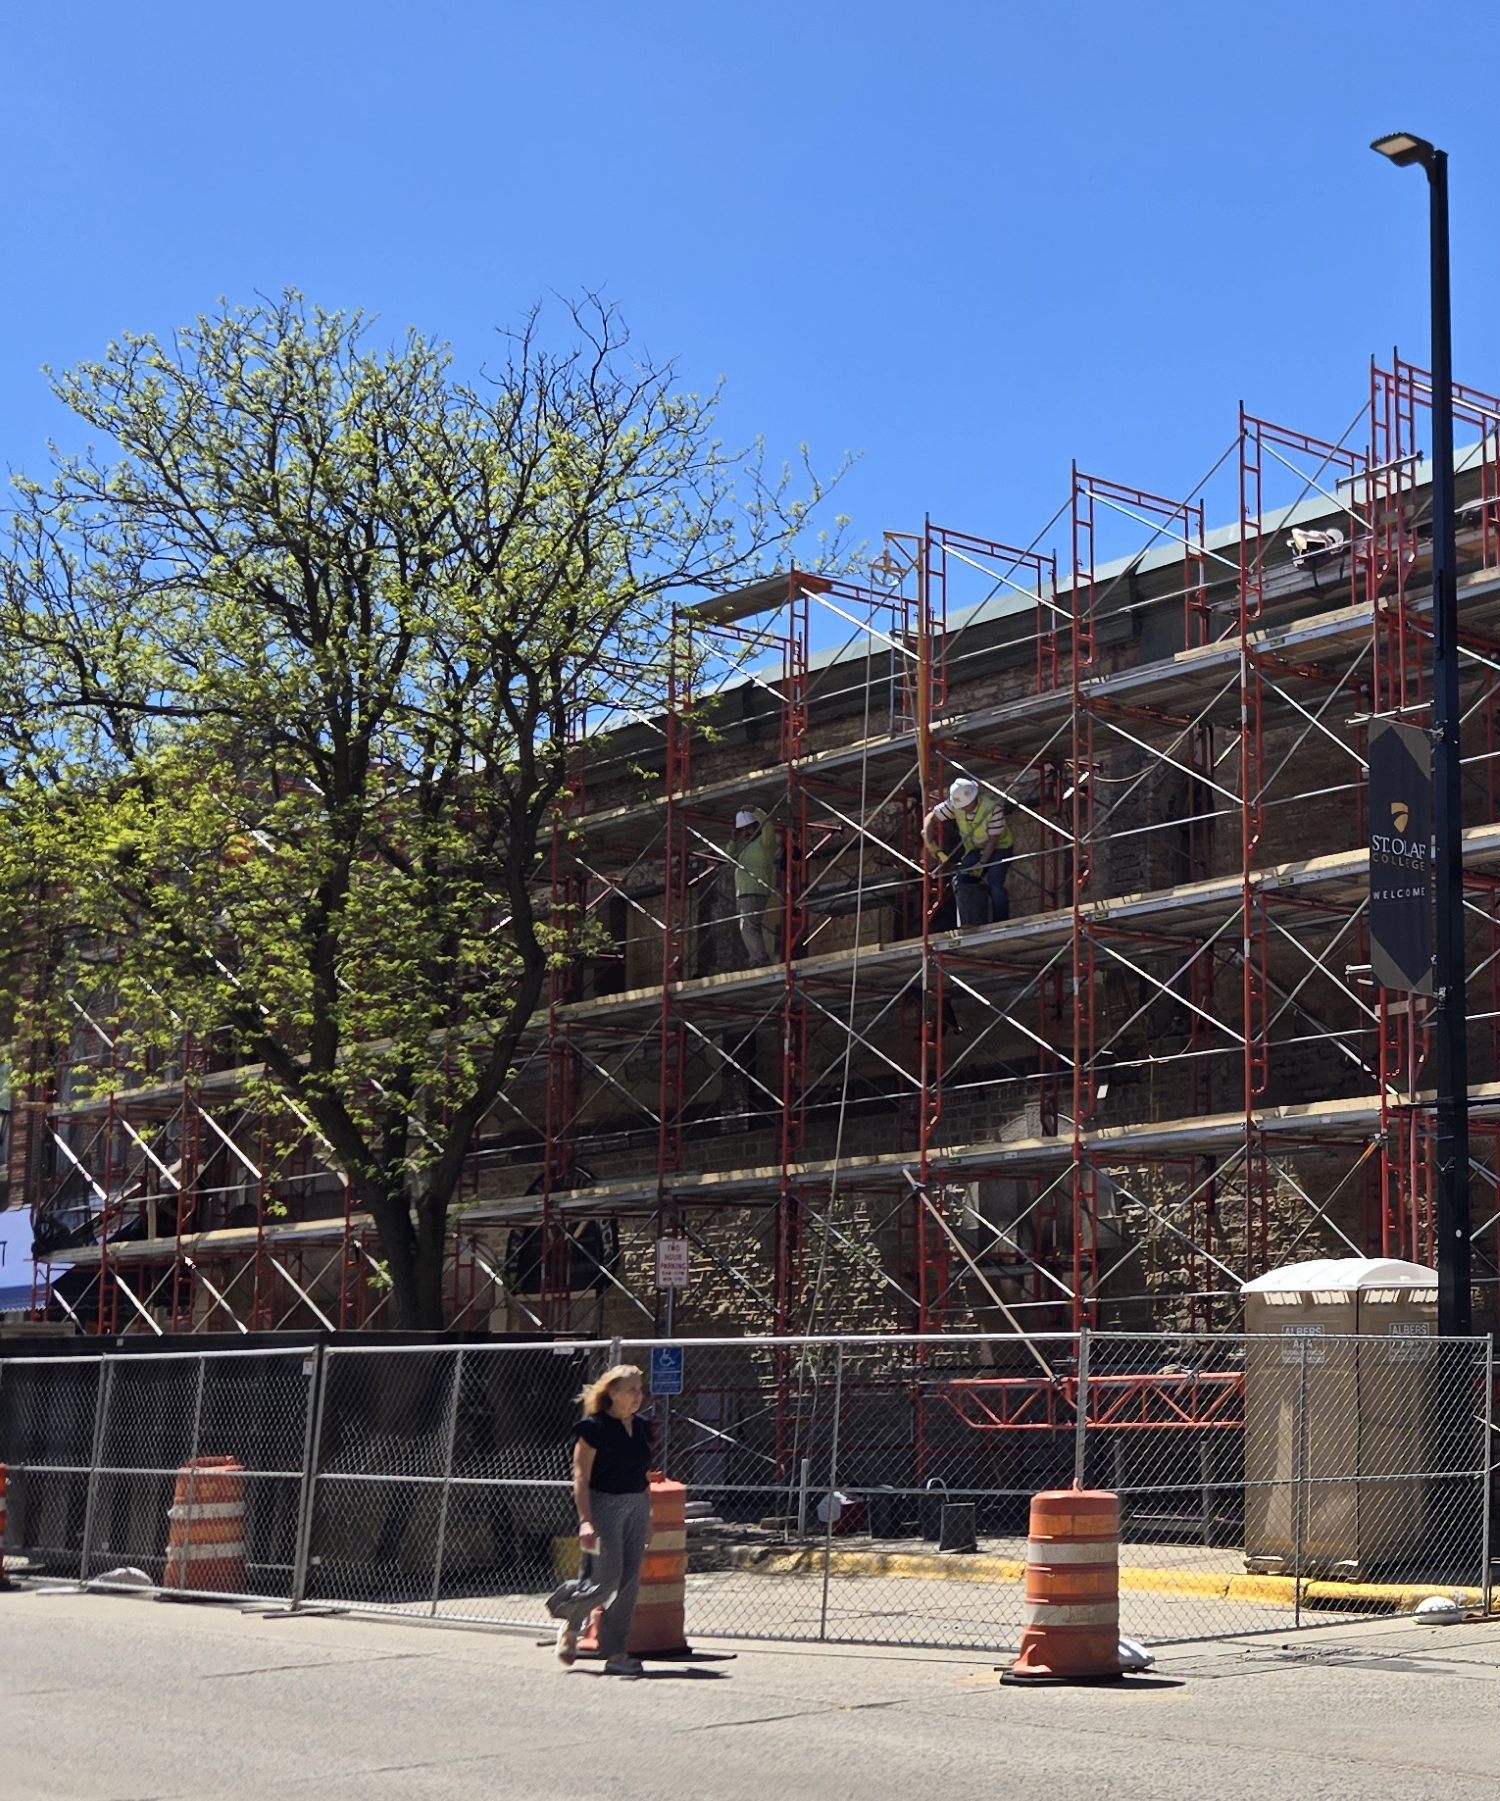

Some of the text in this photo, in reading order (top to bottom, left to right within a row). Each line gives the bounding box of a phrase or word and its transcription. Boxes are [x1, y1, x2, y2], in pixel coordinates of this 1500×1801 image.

[1372, 835, 1426, 860] ST. OLAF
[1372, 853, 1425, 871] COLLEGE
[1373, 888, 1425, 900] WELCOME
[660, 1262, 686, 1270] PARKING
[1285, 1326, 1322, 1335] ALBERS
[1392, 1324, 1427, 1335] ALBERS
